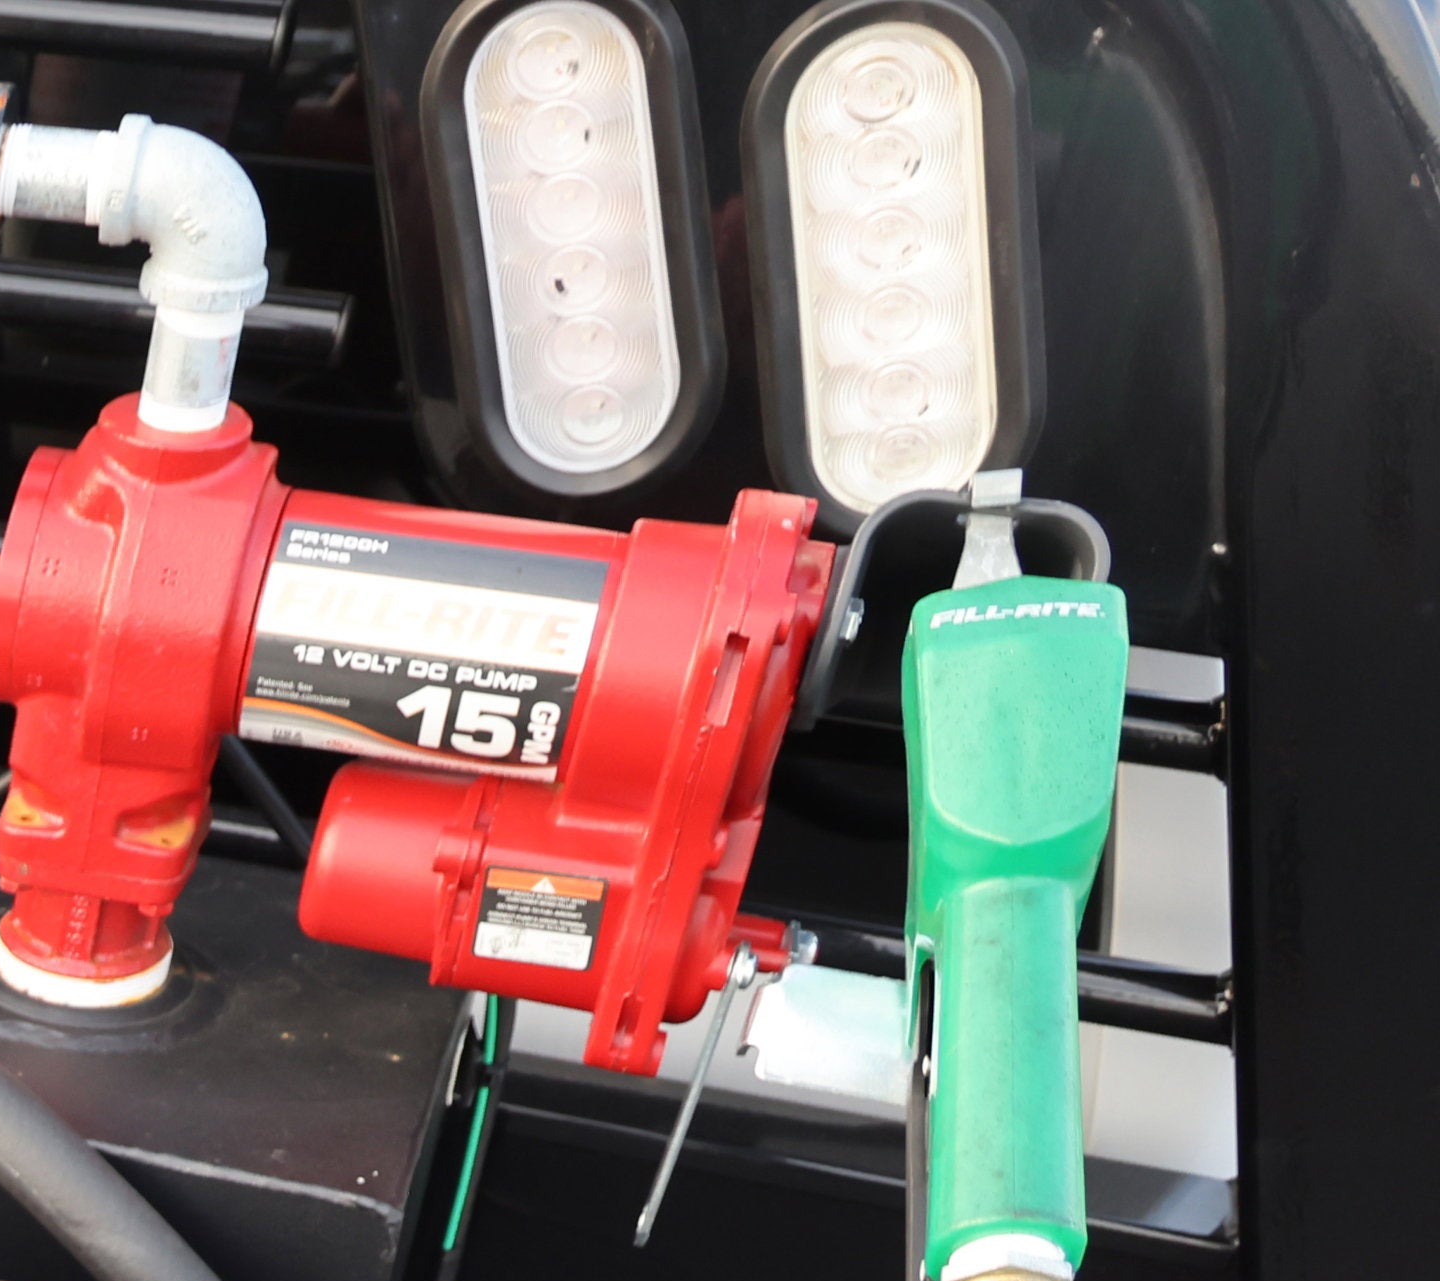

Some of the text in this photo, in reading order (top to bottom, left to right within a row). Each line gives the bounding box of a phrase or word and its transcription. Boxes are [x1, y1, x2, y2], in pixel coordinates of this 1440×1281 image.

[286, 542, 350, 564] Series
[272, 579, 582, 656] FILL-RITE
[293, 644, 538, 693] 12 VOLT DC PUMP
[396, 685, 521, 758] 15
[521, 701, 561, 765] GPM
